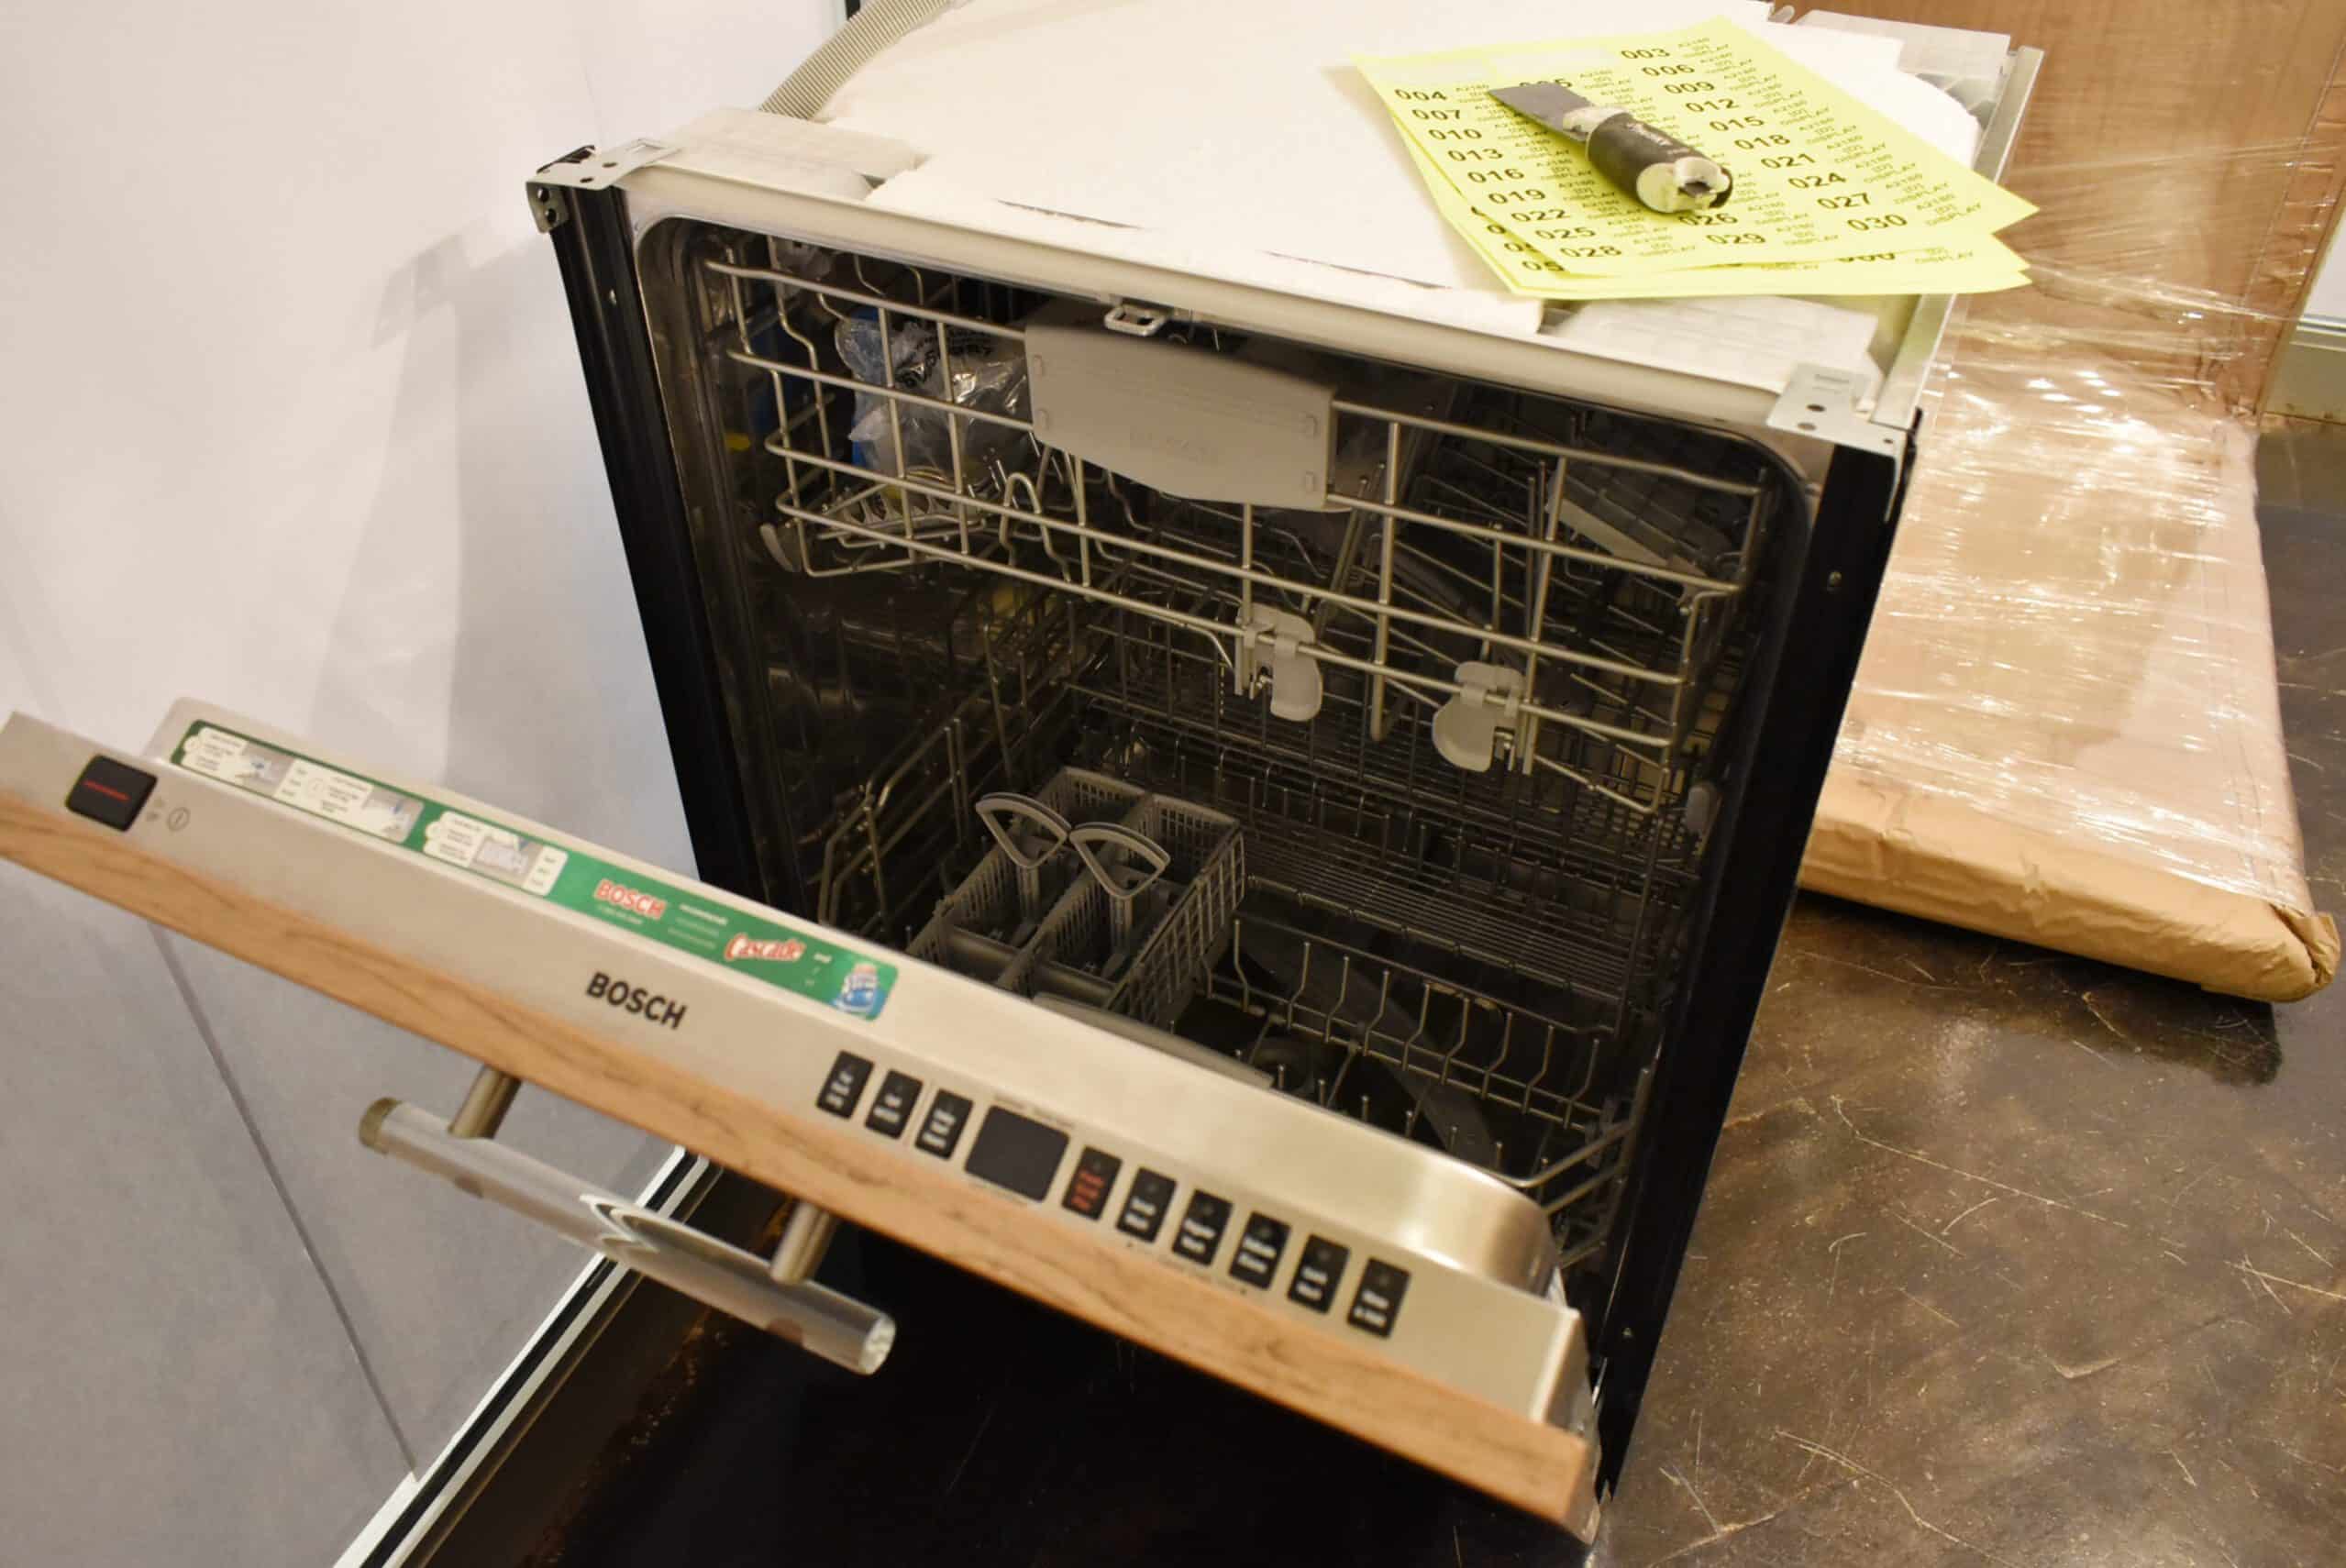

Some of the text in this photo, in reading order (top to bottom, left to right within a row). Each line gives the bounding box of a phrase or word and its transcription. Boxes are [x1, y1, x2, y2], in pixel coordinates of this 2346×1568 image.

[1621, 48, 1670, 59] 003
[1642, 64, 1695, 77] 006
[1664, 81, 1715, 94] 009
[1394, 89, 1447, 101] 004
[1685, 98, 1740, 113] 012
[1411, 109, 1461, 120] 007
[1709, 116, 1765, 131] 015
[1428, 128, 1482, 140] 010
[1734, 135, 1790, 149] 018
[1447, 148, 1503, 161] 013
[1761, 153, 1816, 169] 021
[1467, 168, 1524, 183] 016
[1788, 172, 1846, 189] 024
[1488, 189, 1546, 204] 019
[1817, 192, 1871, 209] 027
[1511, 209, 1570, 222] 022
[1678, 213, 1738, 226] 026
[1847, 214, 1908, 231] 030
[1534, 226, 1596, 239] 025
[1706, 233, 1766, 244] 029
[1560, 246, 1622, 257] 028
[593, 878, 667, 920] BOSCH
[586, 972, 688, 1029] BOSCH
